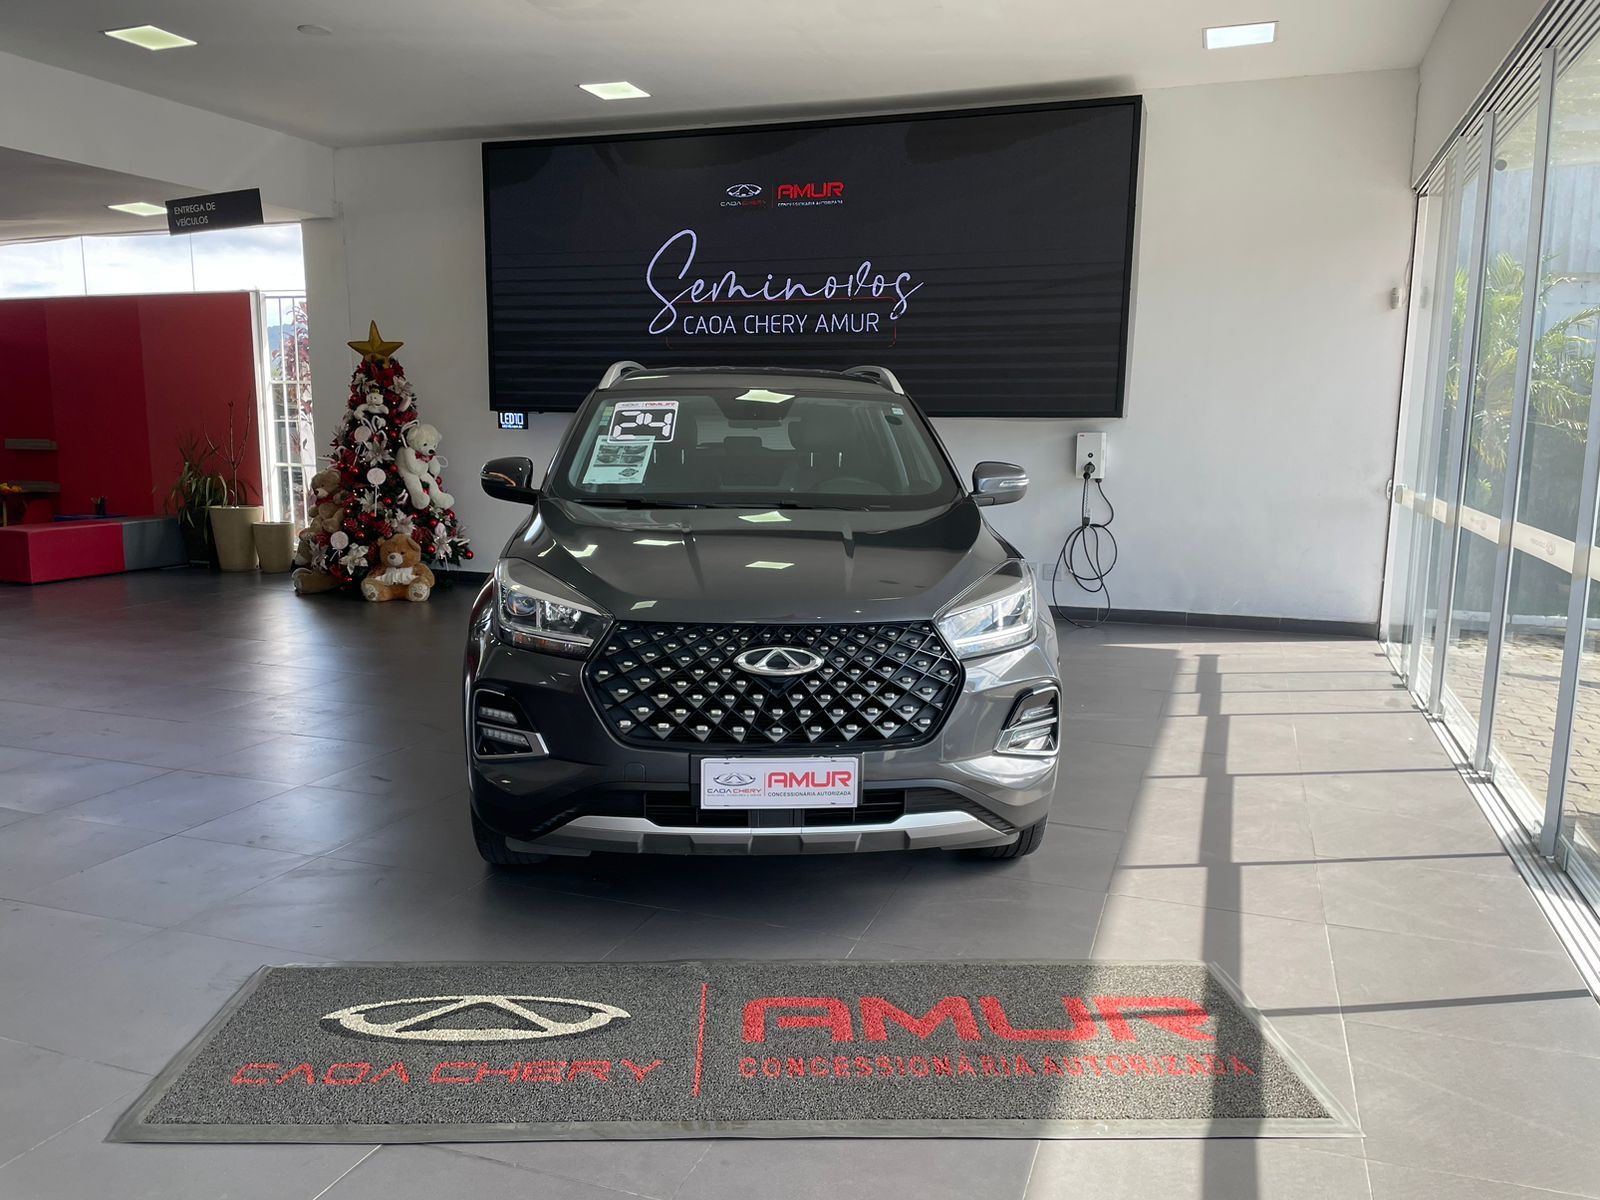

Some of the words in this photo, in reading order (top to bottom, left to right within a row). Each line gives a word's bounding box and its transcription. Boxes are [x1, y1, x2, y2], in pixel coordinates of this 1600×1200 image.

[777, 181, 845, 200] AMUR
[174, 203, 205, 215] ENTREGA
[205, 201, 216, 211] DE
[175, 215, 209, 227] VEÍCULOS
[646, 229, 924, 335] Seminovos
[683, 314, 737, 335] CAOA
[743, 314, 808, 334] CHERY
[814, 312, 880, 333] AMUR
[612, 411, 673, 440] 24
[767, 770, 852, 788] AMUR
[742, 995, 1217, 1042] AMUR
[230, 1062, 411, 1086] CAOA
[427, 1059, 664, 1084] CHERY
[1043, 1054, 1256, 1077] AUTORIZADA
